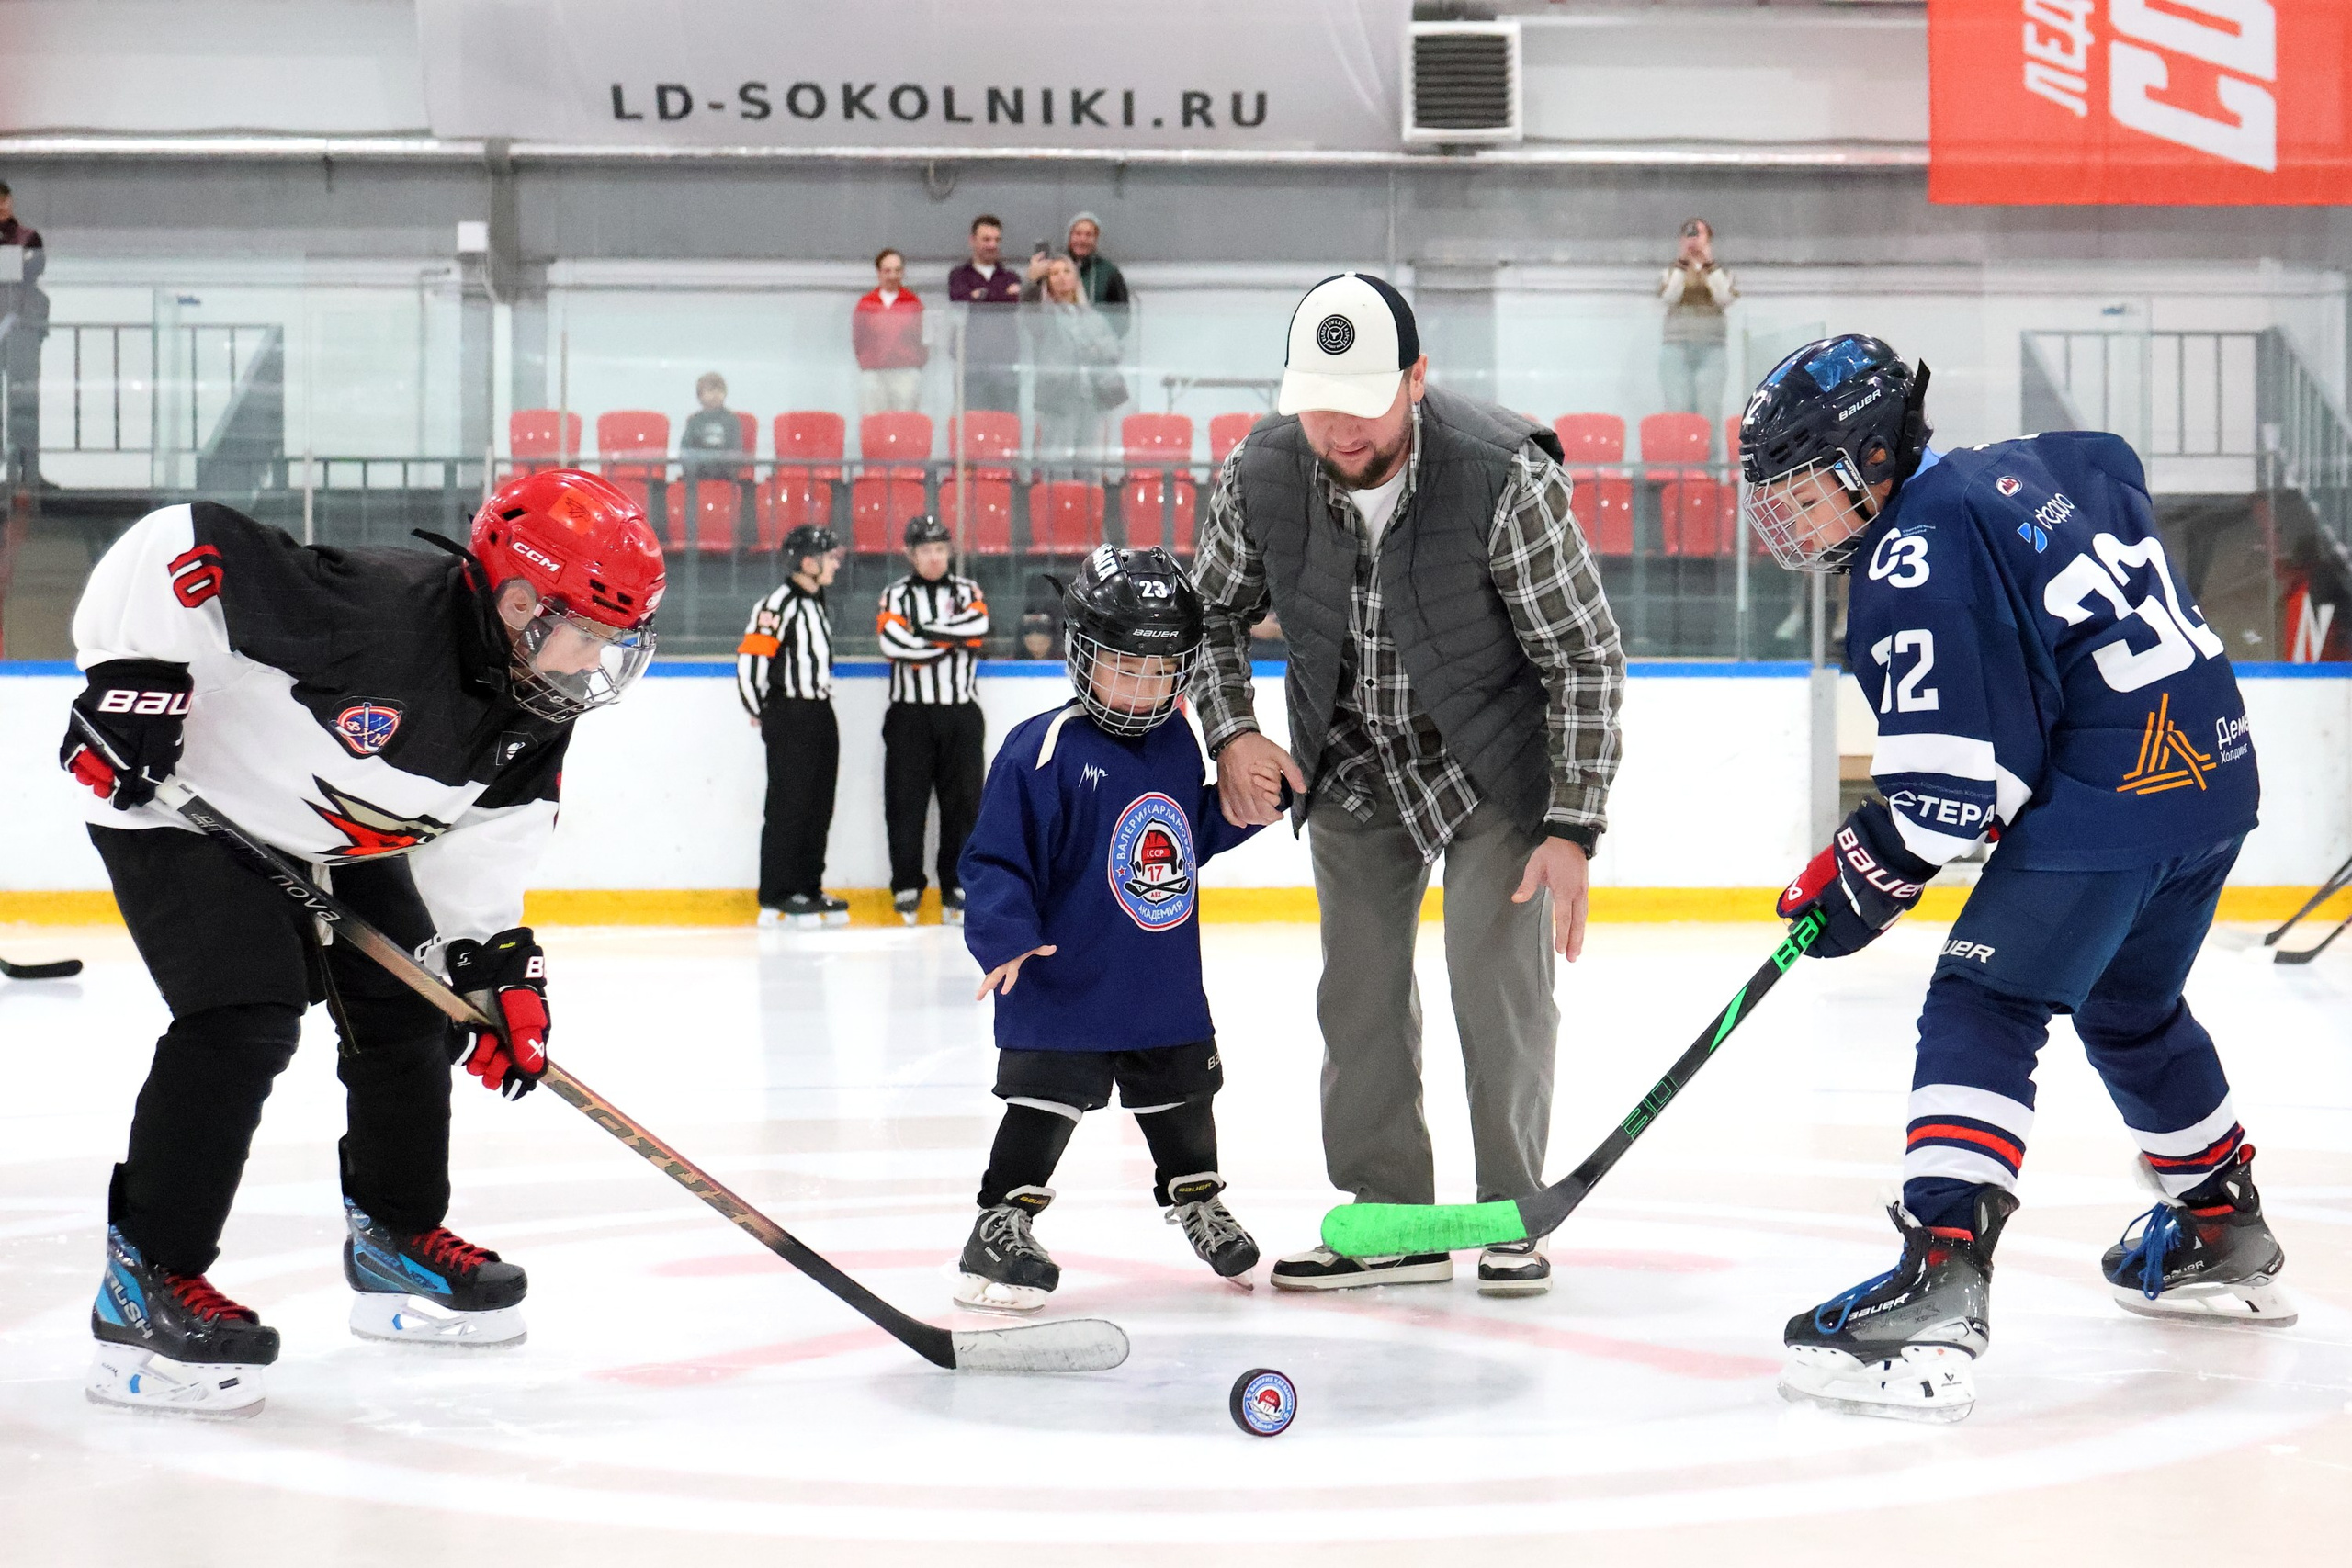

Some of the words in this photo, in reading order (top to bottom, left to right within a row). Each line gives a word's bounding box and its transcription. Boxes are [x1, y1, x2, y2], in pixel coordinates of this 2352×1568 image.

[610, 81, 1269, 129] LD-SOKOLNIKI.RU
[1838, 389, 1882, 422] BAUER
[512, 541, 560, 572] CCM
[167, 544, 224, 608] 10
[1139, 580, 1168, 599] 23
[2044, 532, 2225, 693] 32
[1132, 628, 1180, 638] BAUER
[345, 719, 390, 746] ФХМ
[2220, 742, 2248, 765] Холдинг
[1147, 849, 1165, 858] СССР
[1148, 864, 1165, 882] 17
[271, 874, 342, 922] nova
[1137, 899, 1184, 922] АКАДЕМИЯ
[1178, 1181, 1212, 1193] BAUER
[1848, 1292, 1911, 1321] BAUER
[1263, 1403, 1272, 1413] 17
